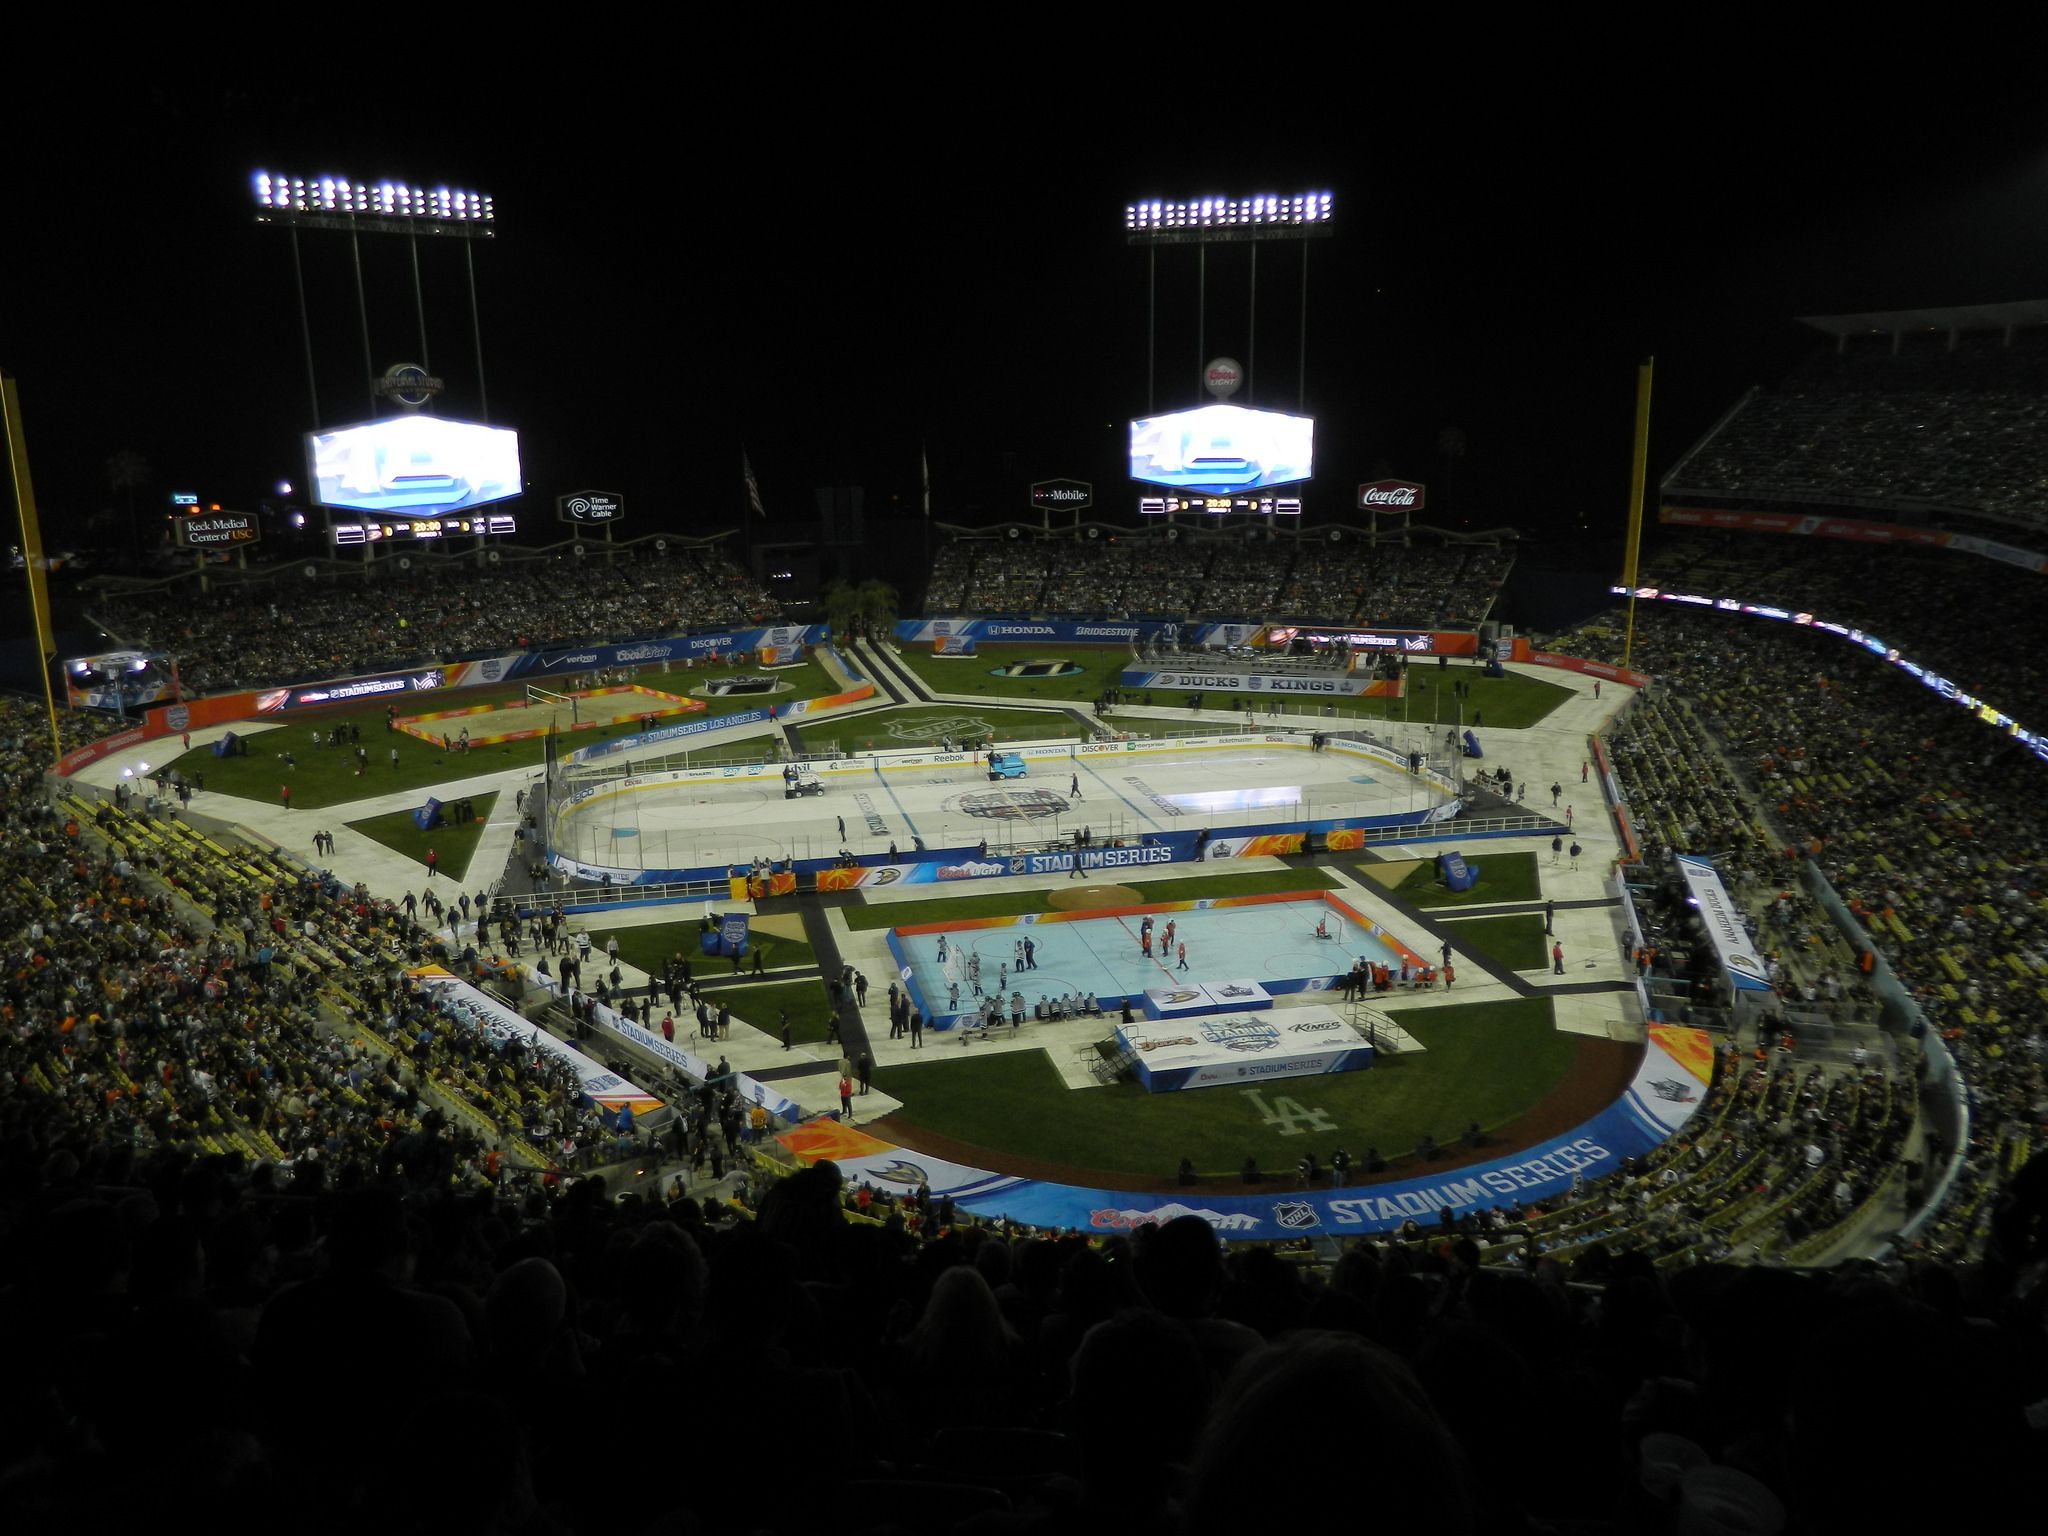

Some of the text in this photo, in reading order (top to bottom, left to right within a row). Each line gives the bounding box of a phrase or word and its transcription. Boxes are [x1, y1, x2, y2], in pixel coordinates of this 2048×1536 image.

[188, 518, 248, 532] Keck Medical
[414, 521, 441, 532] 20:00
[189, 528, 253, 543] Center of USC
[1001, 626, 1056, 635] HONDA
[1076, 626, 1139, 637] BRIDGESTONE
[691, 637, 733, 649] DISCOVER
[566, 654, 597, 664] verizon
[1180, 675, 1240, 688] DUCKS
[1270, 679, 1336, 691] KINGS
[709, 719, 725, 730] LOS
[726, 711, 761, 728] ANGELES
[1219, 736, 1254, 744] ticketmaster
[1082, 744, 1119, 753] DISCOVER
[934, 754, 965, 762] Reebok
[1105, 846, 1172, 866] SERIES
[937, 861, 1003, 879] Coors LIGHT
[1289, 1021, 1342, 1033] KINGS
[1202, 1026, 1280, 1042] STADIUM
[1239, 1088, 1339, 1136] LA
[1329, 1138, 1610, 1224] STADIUM SERIES
[1287, 1209, 1310, 1223] NHL
